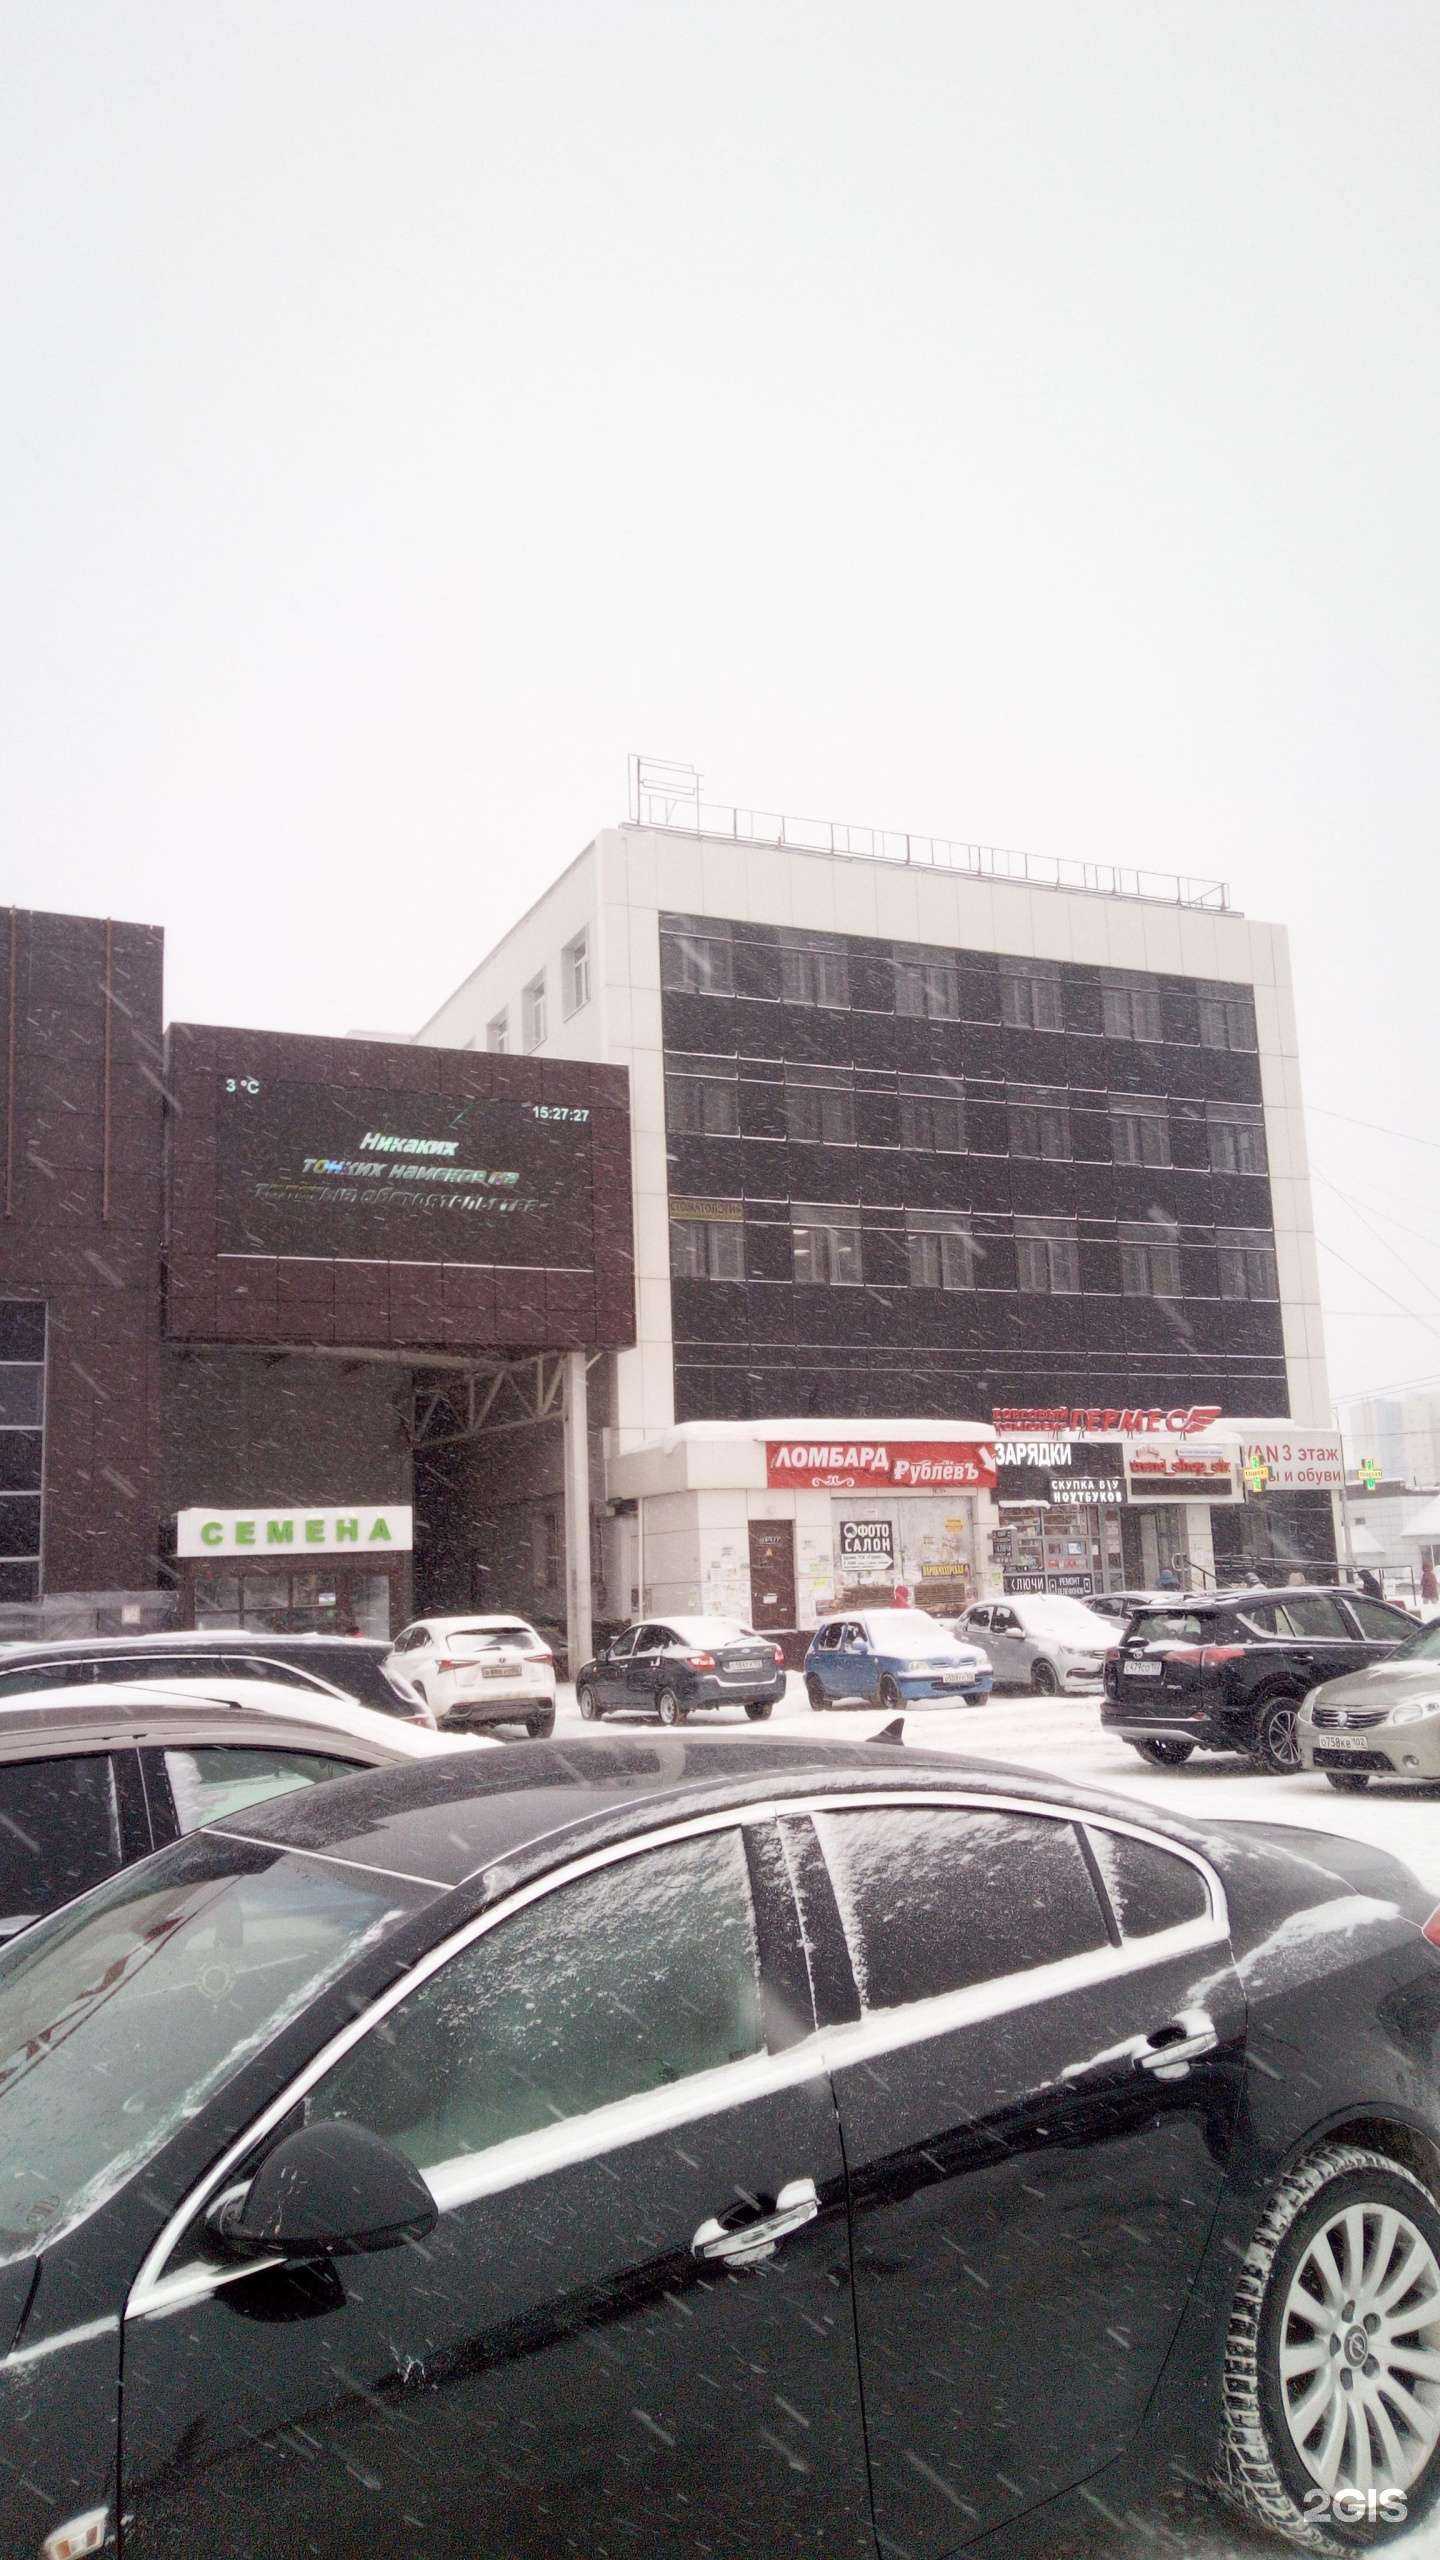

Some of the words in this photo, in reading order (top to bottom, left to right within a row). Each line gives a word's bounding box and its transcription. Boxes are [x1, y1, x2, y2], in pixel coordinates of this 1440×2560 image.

[226, 1079, 236, 1092] 3
[533, 1105, 590, 1122] 15:27:27
[359, 1131, 460, 1156] Никаких
[773, 1447, 889, 1471] ЛОМБАРД
[995, 1443, 1072, 1467] ЗАРЯДКИ
[1282, 1444, 1292, 1461] 3
[1297, 1448, 1339, 1462] этаж
[1051, 1480, 1095, 1490] СКУПКА
[1284, 1471, 1293, 1482] и
[1297, 1468, 1342, 1486] обуви
[1054, 1491, 1123, 1503] НОУТБУКОВ
[200, 1517, 393, 1546] СЕМЕНА
[858, 1523, 890, 1538] ФОТО
[844, 1538, 891, 1552] САЛОН
